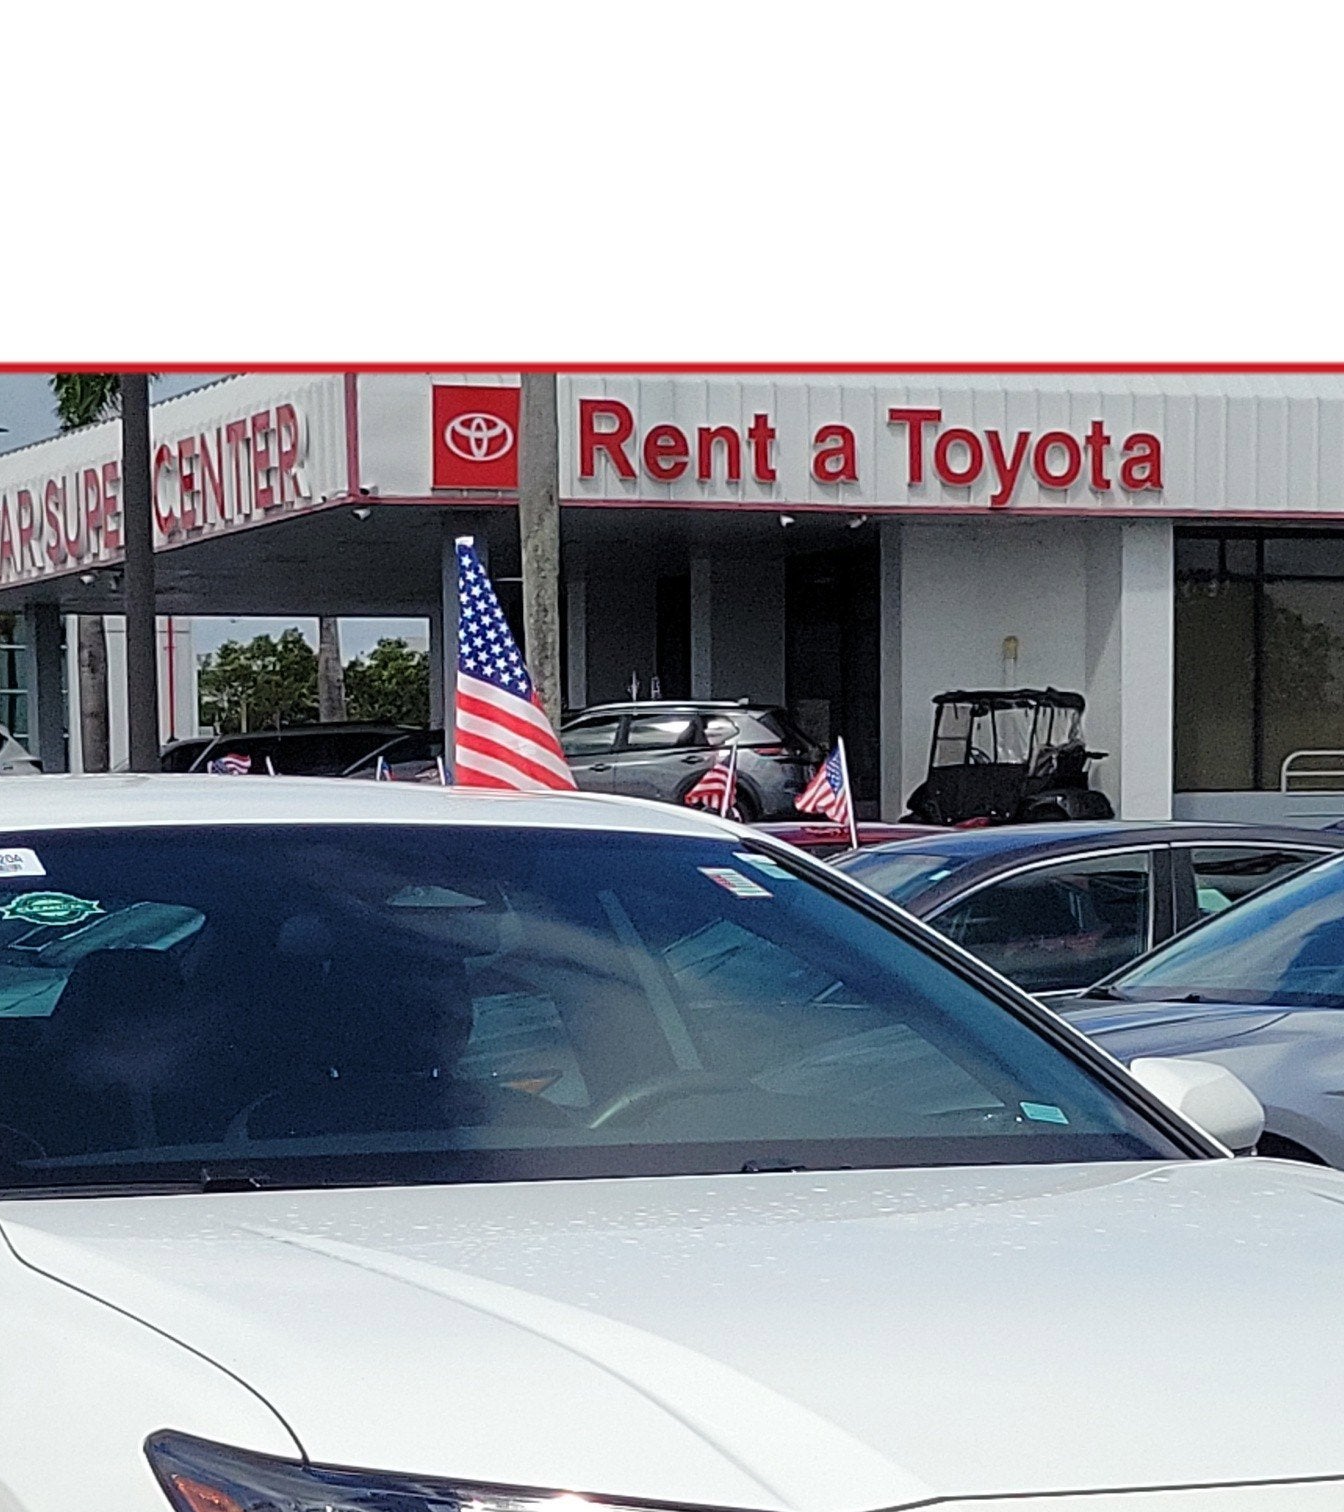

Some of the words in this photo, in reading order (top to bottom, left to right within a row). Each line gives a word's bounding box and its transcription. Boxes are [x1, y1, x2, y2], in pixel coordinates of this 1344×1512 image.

[44, 460, 124, 563] SUPE
[154, 403, 311, 536] CENTER
[579, 399, 778, 484] Rent
[812, 423, 857, 484] a
[888, 408, 1163, 506] Toyota
